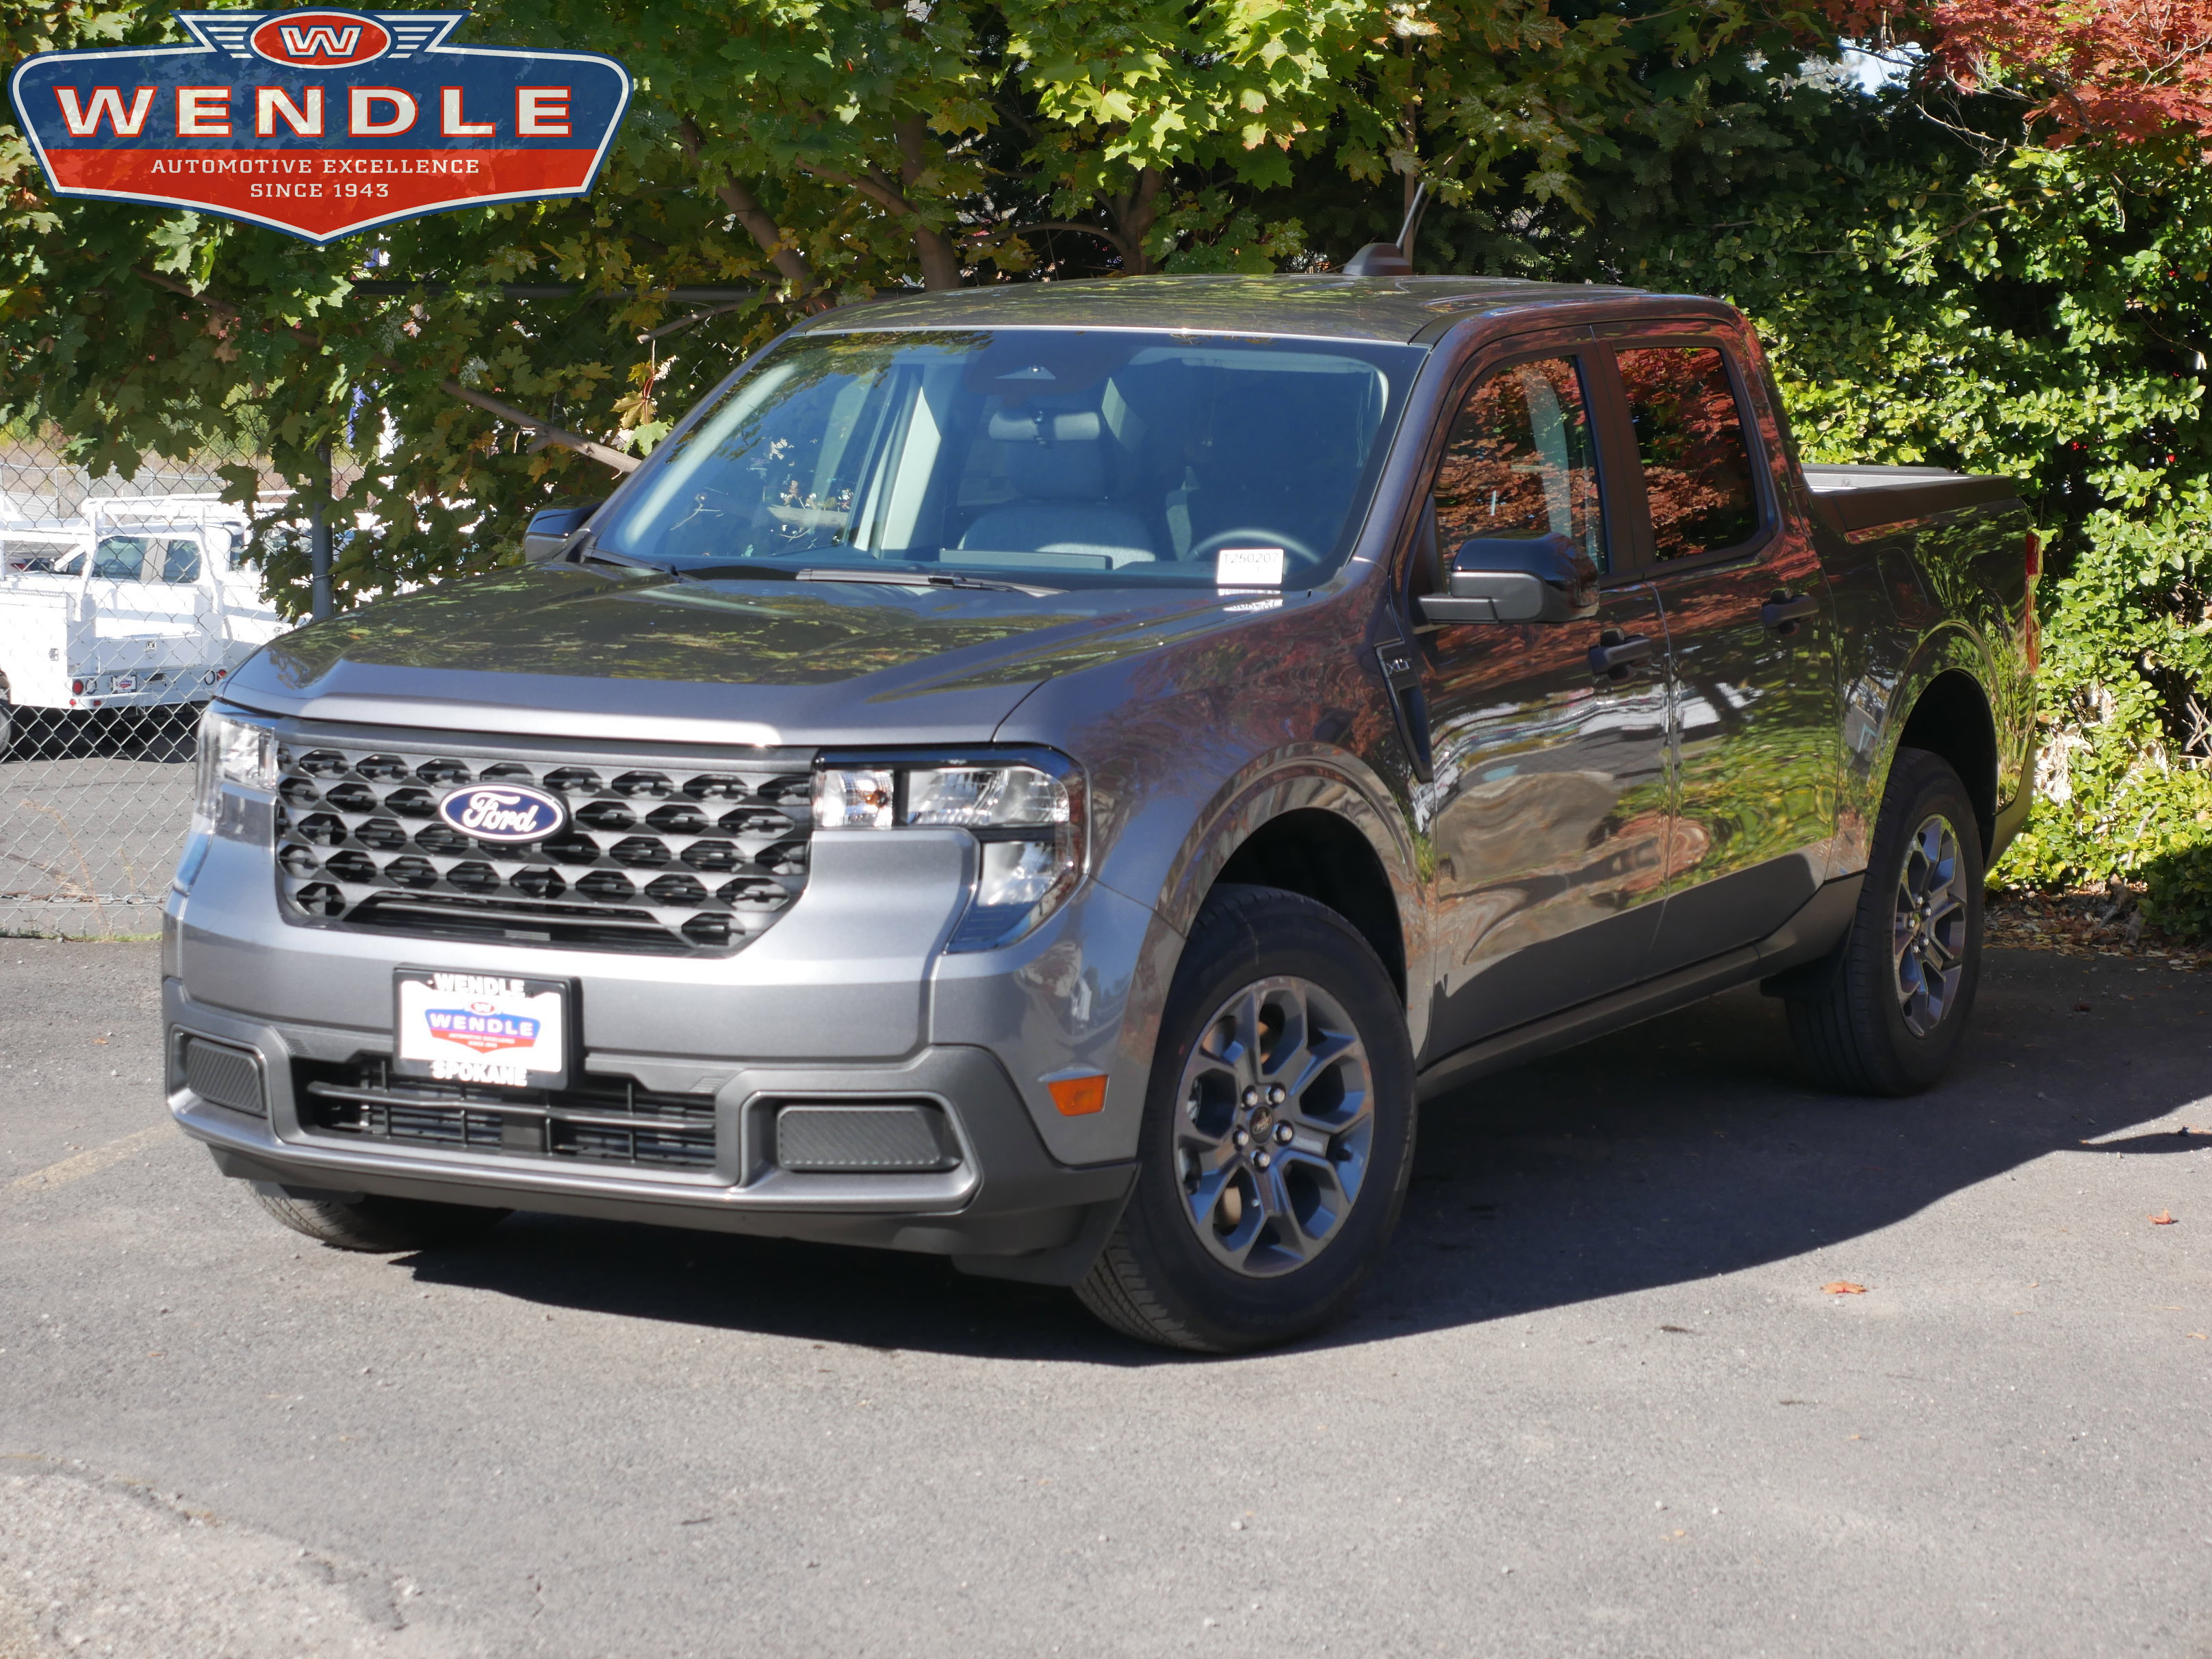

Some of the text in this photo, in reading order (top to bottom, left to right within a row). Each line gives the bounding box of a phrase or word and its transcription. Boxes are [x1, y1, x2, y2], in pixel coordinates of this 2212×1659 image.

[462, 791, 539, 832] Ford
[433, 973, 526, 998] WENDLE
[429, 1013, 533, 1037] WENDLE
[432, 1059, 528, 1087] SPOKANE
